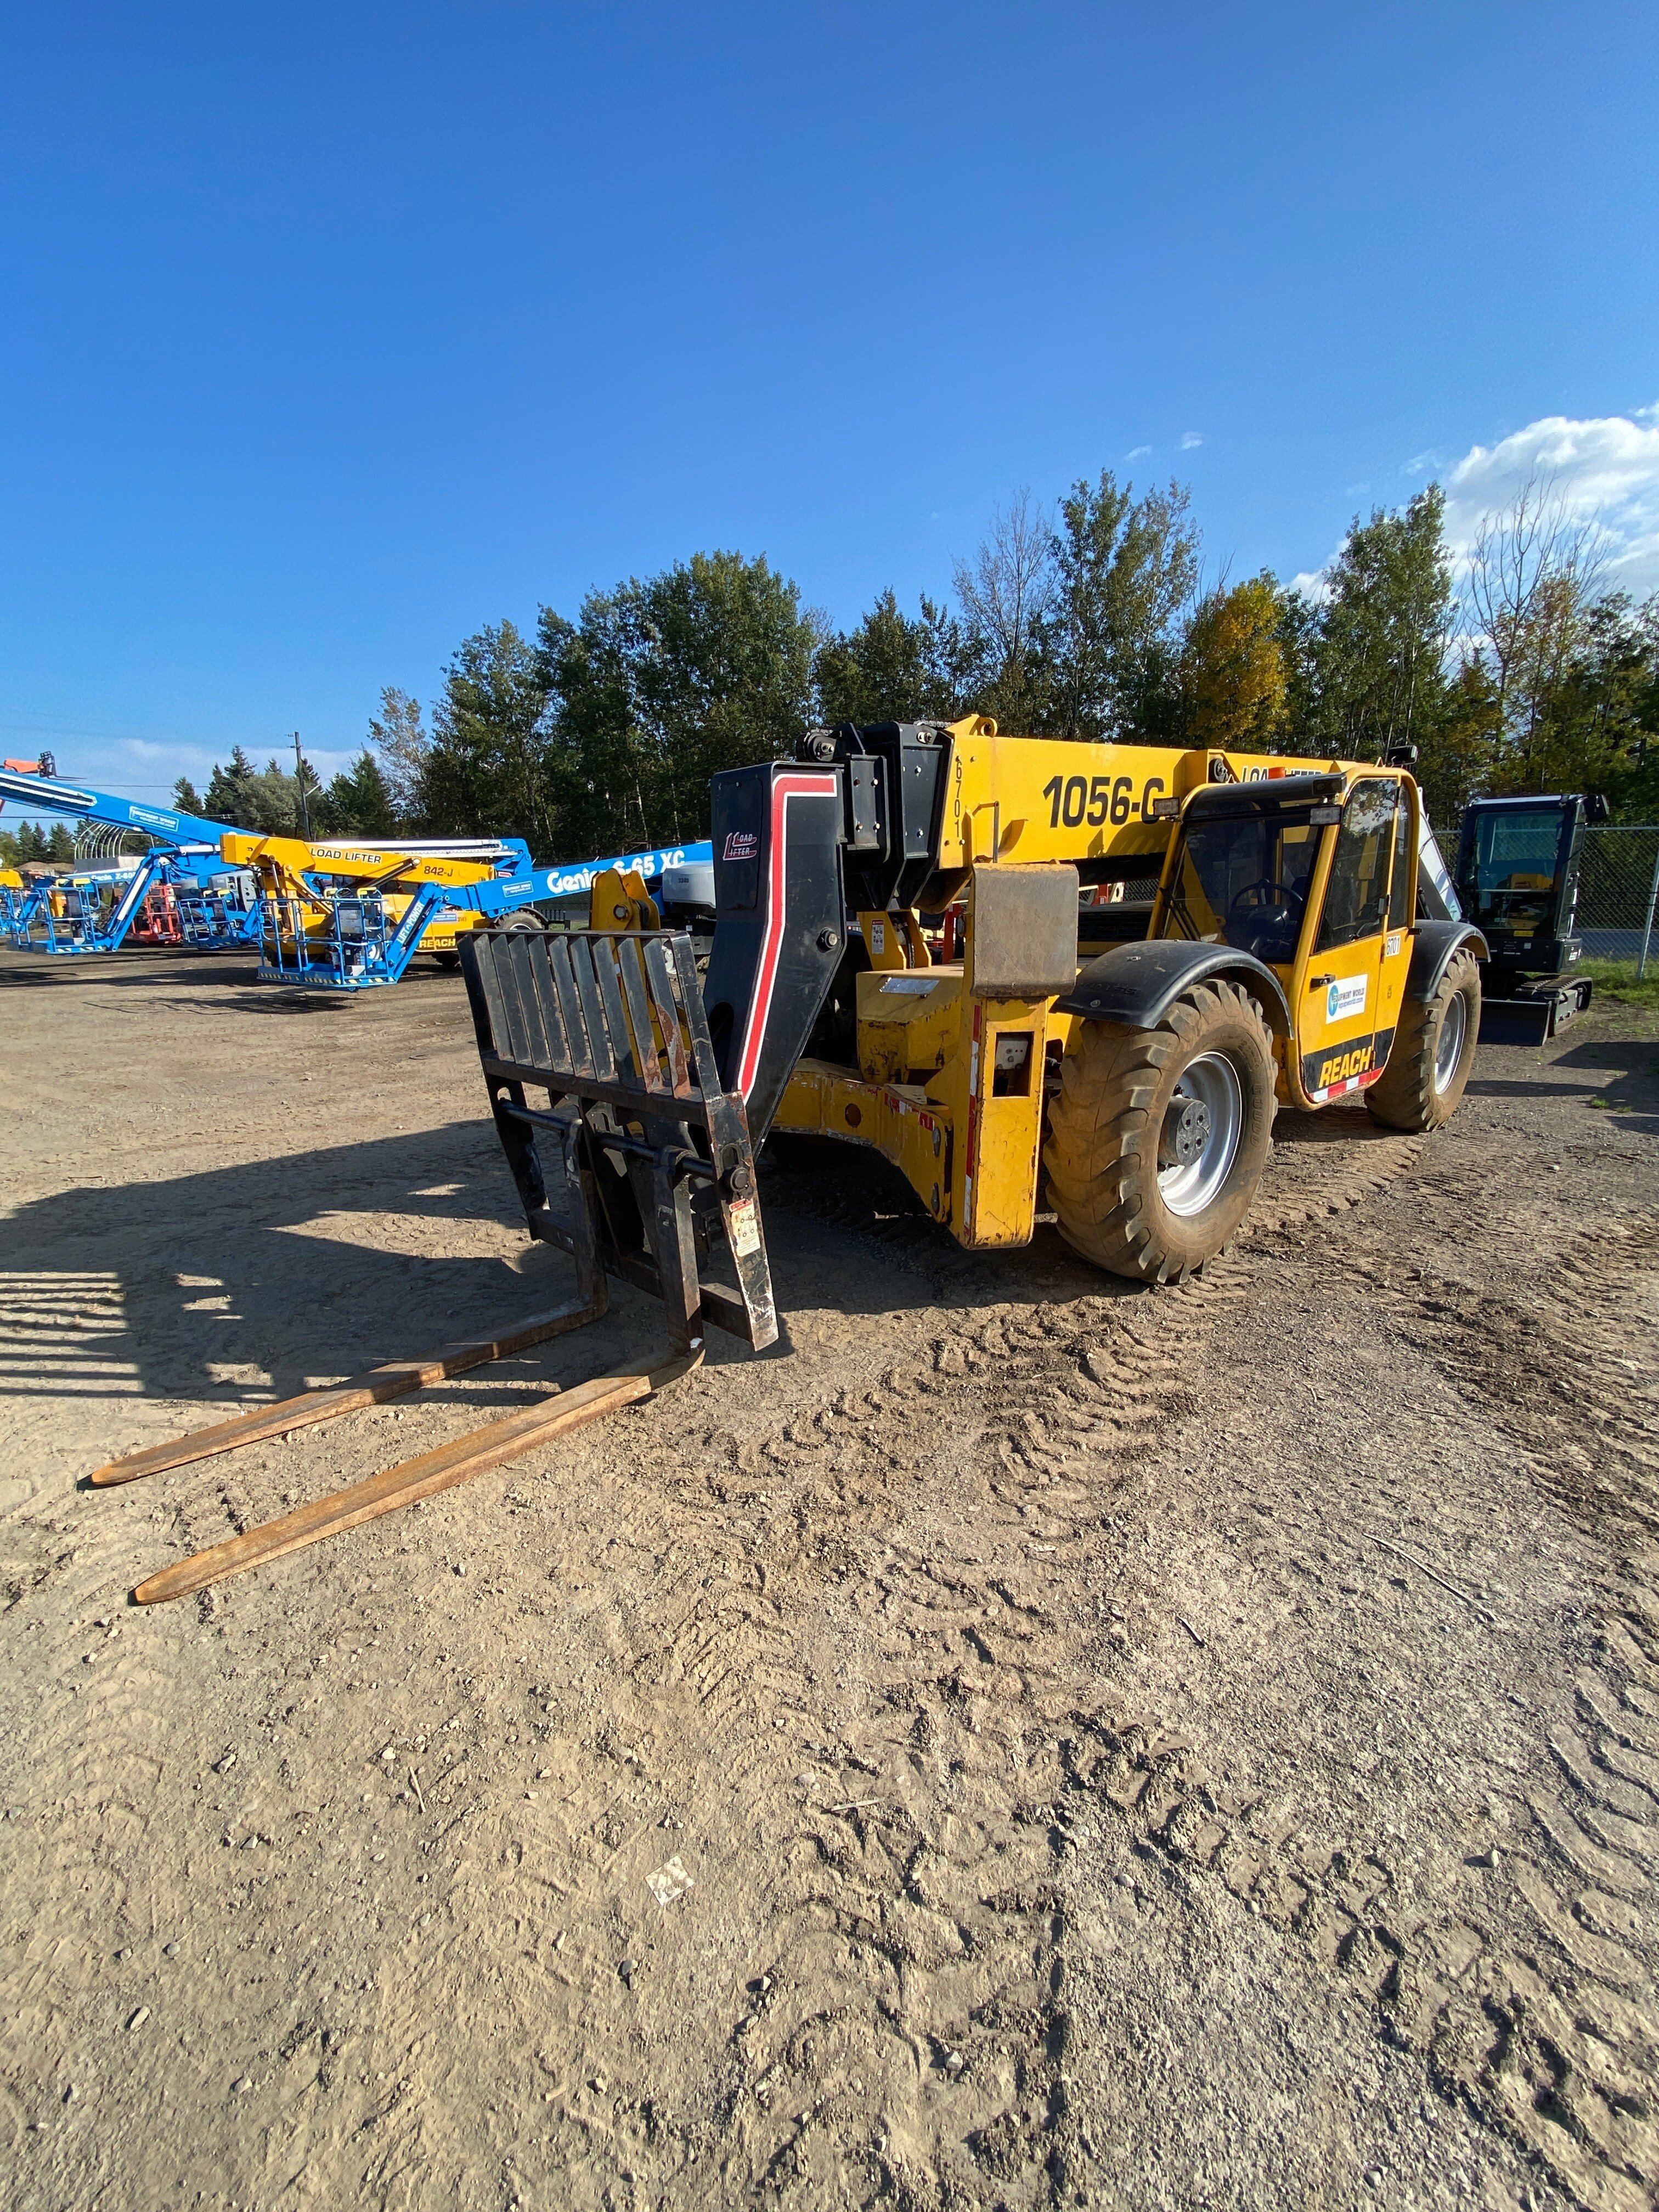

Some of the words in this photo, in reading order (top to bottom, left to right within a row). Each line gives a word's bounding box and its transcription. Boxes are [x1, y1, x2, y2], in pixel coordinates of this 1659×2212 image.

[311, 848, 341, 859] LOAD
[345, 851, 381, 864] LIFTER
[660, 850, 686, 873] XC
[424, 865, 454, 877] 842-J
[419, 938, 456, 949] REACH
[1386, 936, 1400, 955] 6701
[1318, 1046, 1373, 1088] REACH
